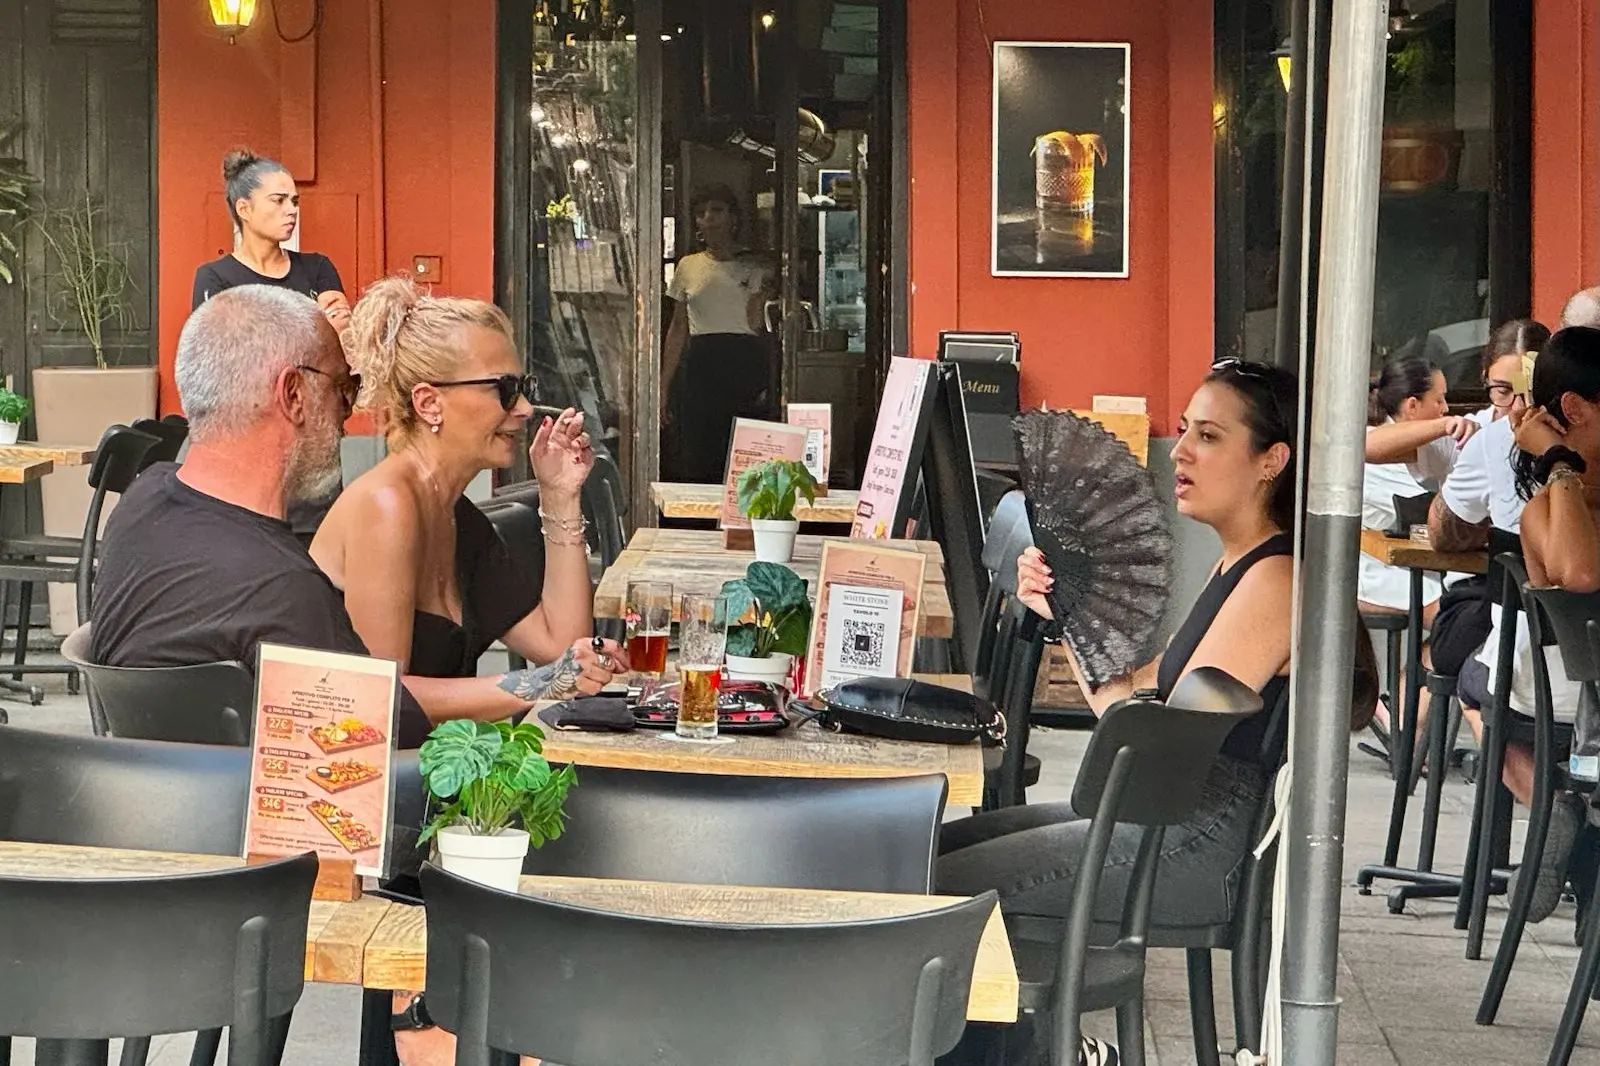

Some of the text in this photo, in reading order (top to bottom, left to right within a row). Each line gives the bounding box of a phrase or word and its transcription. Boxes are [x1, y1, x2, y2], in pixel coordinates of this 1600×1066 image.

[962, 380, 1000, 393] Menu
[269, 719, 289, 730] 27€
[265, 760, 285, 771] 25€
[262, 798, 281, 810] 34€
